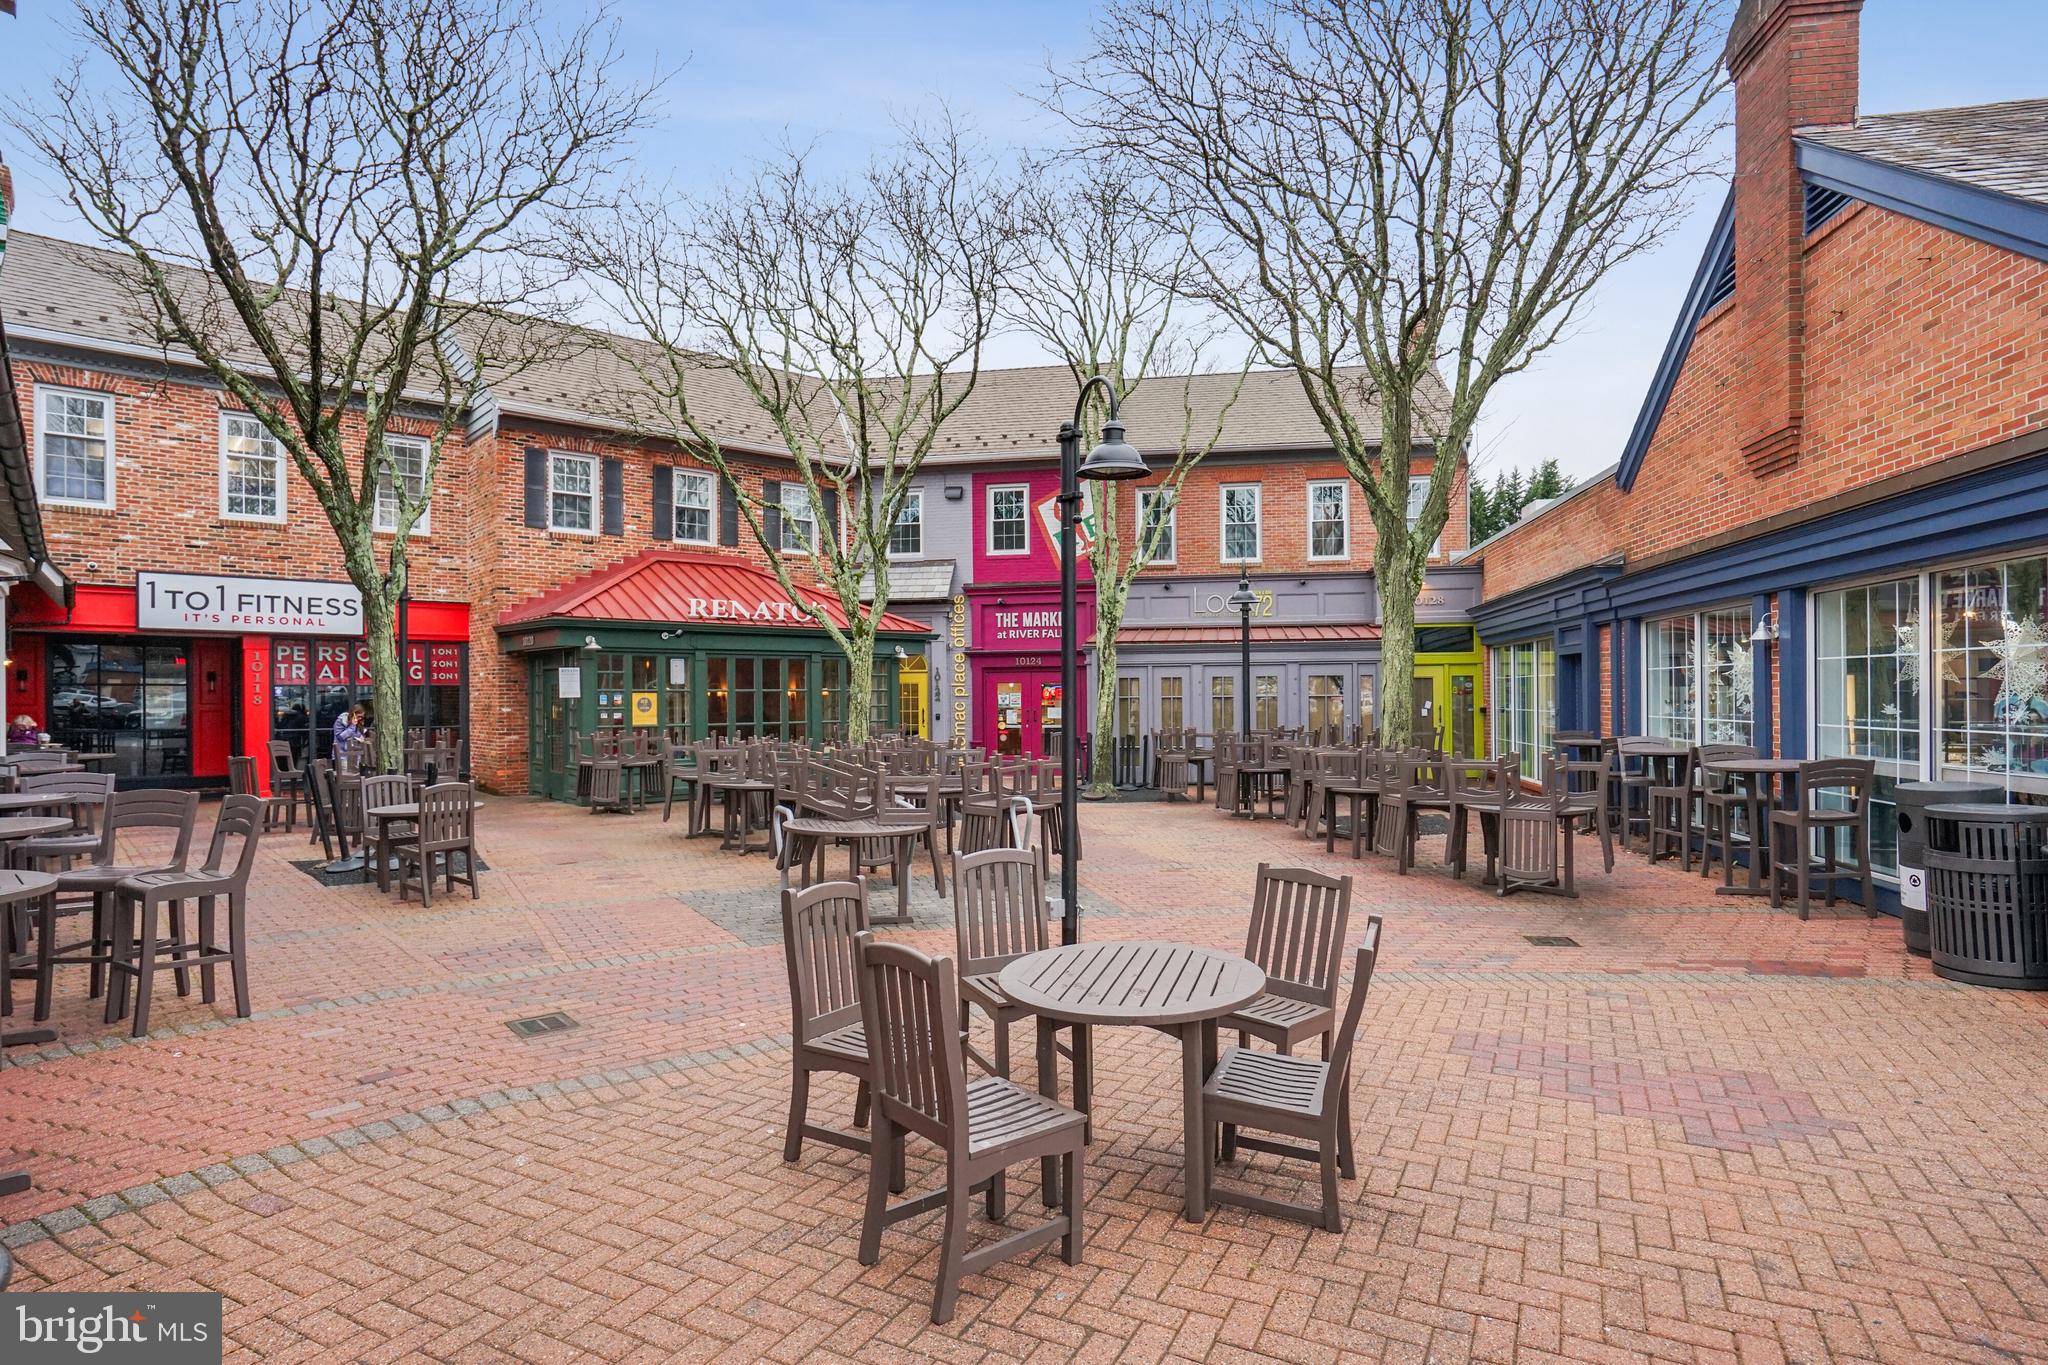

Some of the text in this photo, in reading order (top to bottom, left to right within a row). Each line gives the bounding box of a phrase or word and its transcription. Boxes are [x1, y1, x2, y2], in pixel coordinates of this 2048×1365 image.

[146, 581, 358, 616] 1 TO 1 FITNESS
[184, 613, 326, 627] IT'S PERSONAL
[951, 594, 965, 648] offices
[995, 613, 1019, 628] THE
[997, 631, 1007, 639] at
[1009, 630, 1040, 639] RIVER
[277, 645, 422, 663] PERSOL
[438, 648, 453, 656] ON
[438, 660, 453, 668] ON
[1015, 657, 1042, 666] 10124
[438, 672, 453, 680] ON
[952, 652, 969, 697] place
